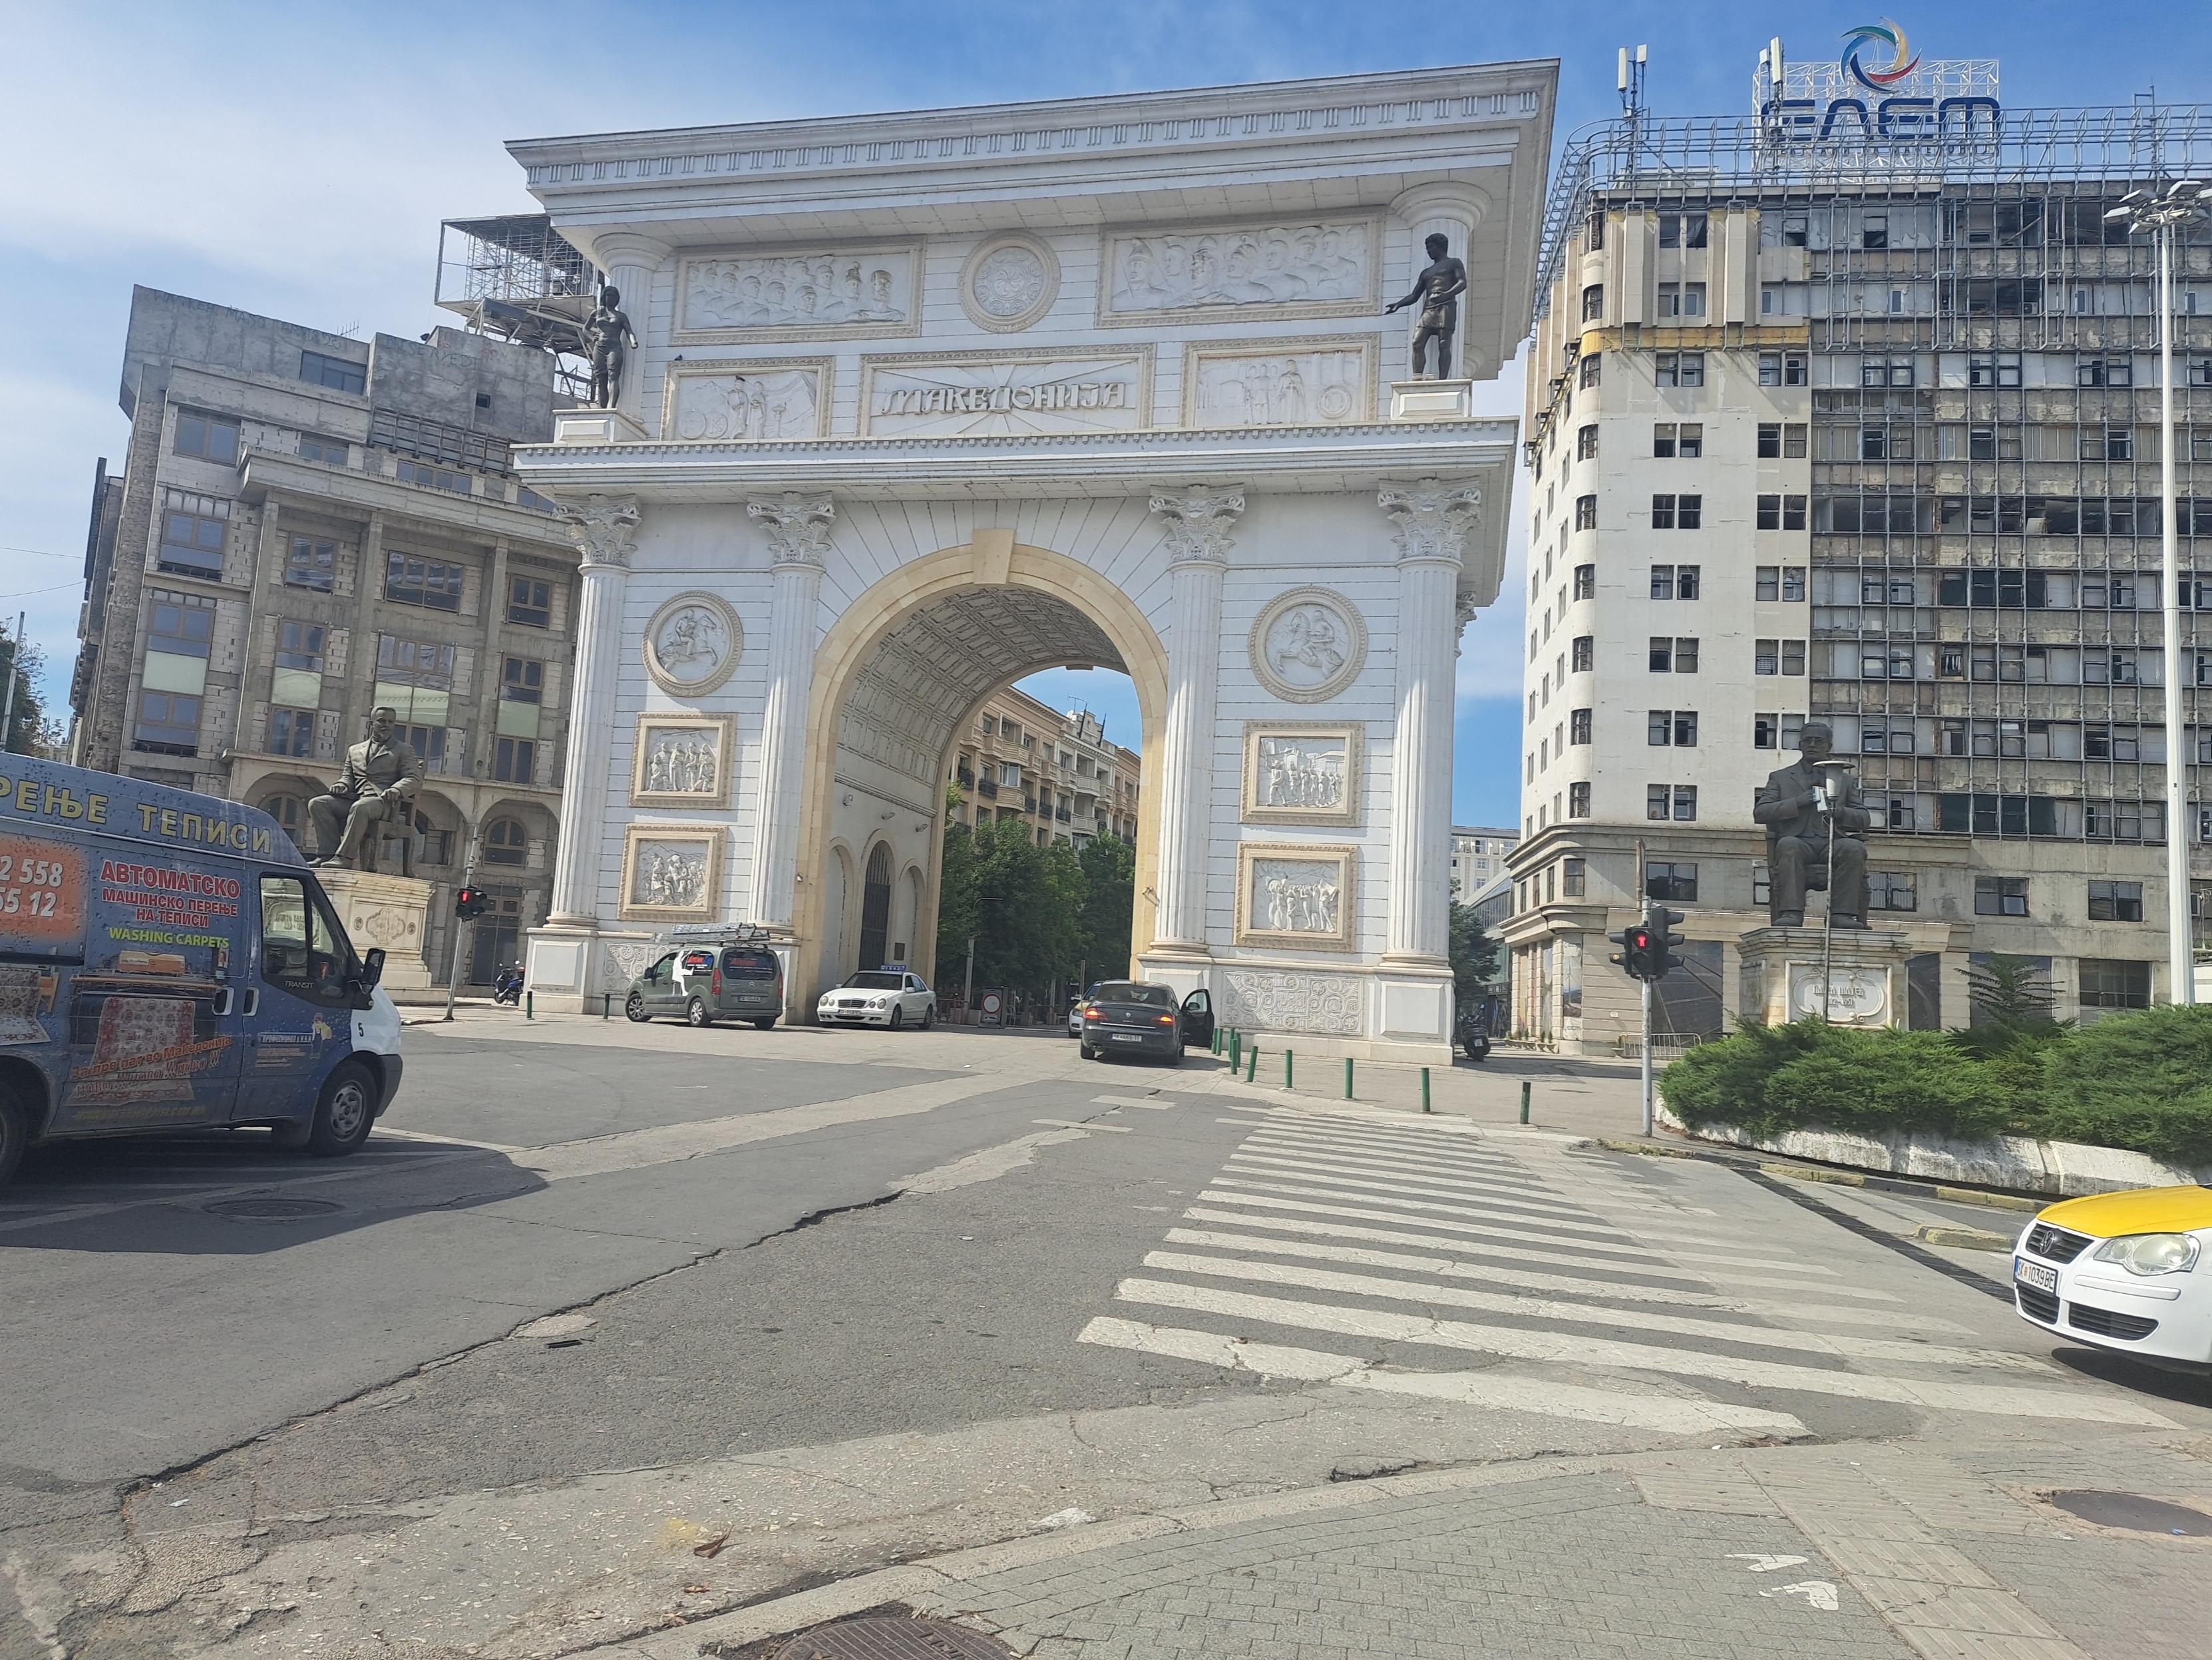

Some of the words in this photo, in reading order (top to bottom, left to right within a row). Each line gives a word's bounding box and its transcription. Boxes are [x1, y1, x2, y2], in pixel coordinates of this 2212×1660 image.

[880, 382, 1126, 415] МАКЕДОНИЈА
[136, 803, 271, 854] ТЕПИСИ
[19, 858, 63, 887] 558
[100, 859, 240, 899] АВТОМАТСКО
[29, 891, 57, 917] 12
[102, 887, 184, 911] МАШИНСКО
[188, 899, 238, 917] ПЕРЕЊЕ
[136, 908, 154, 922] НА
[158, 910, 209, 928] ТЕПИСИ
[109, 927, 173, 944] WASHING
[176, 933, 230, 948] CARPETS
[285, 980, 314, 989] TRANSIT
[1813, 985, 1836, 995] ПАЕЛ
[357, 1022, 365, 1038] 5
[164, 1036, 232, 1060] Македонија
